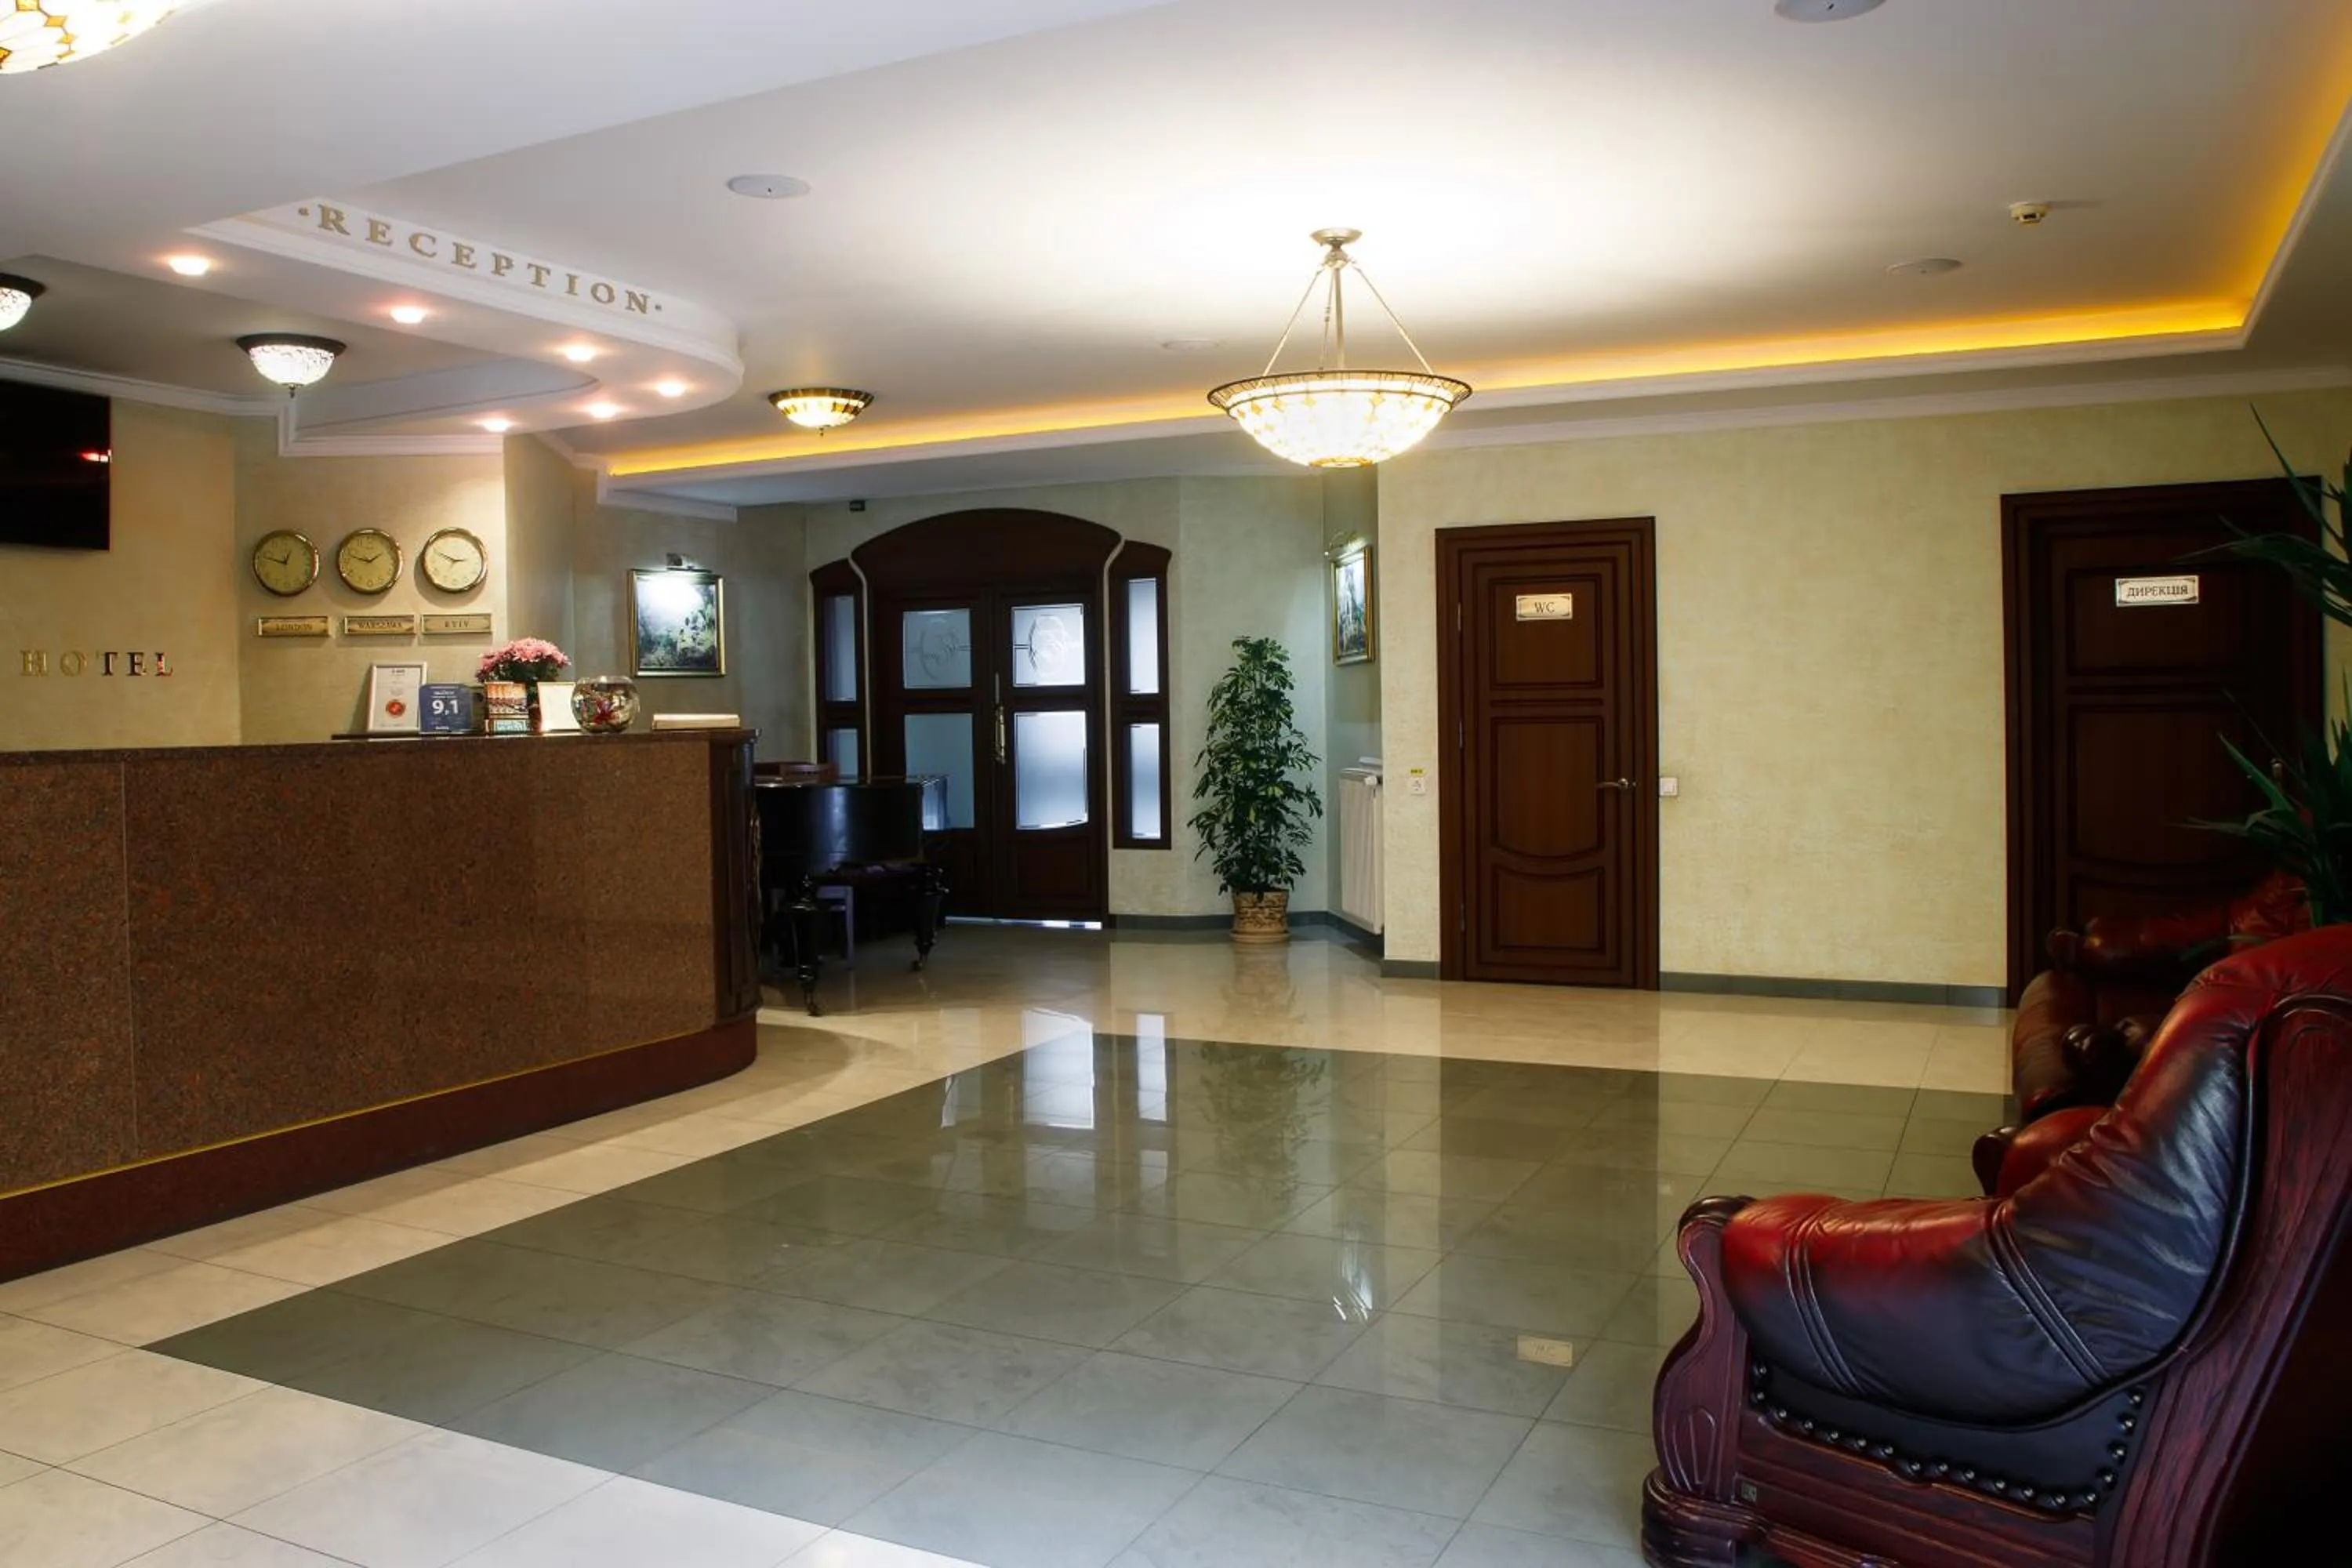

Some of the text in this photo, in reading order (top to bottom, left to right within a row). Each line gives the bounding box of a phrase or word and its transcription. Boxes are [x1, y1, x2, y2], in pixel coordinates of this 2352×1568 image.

[317, 204, 650, 314] RECEPTION
[2127, 585, 2188, 597] ДИРЕКЦІЯ
[1534, 601, 1555, 613] WC
[20, 650, 173, 677] HOTEL
[432, 699, 458, 715] 9,1
